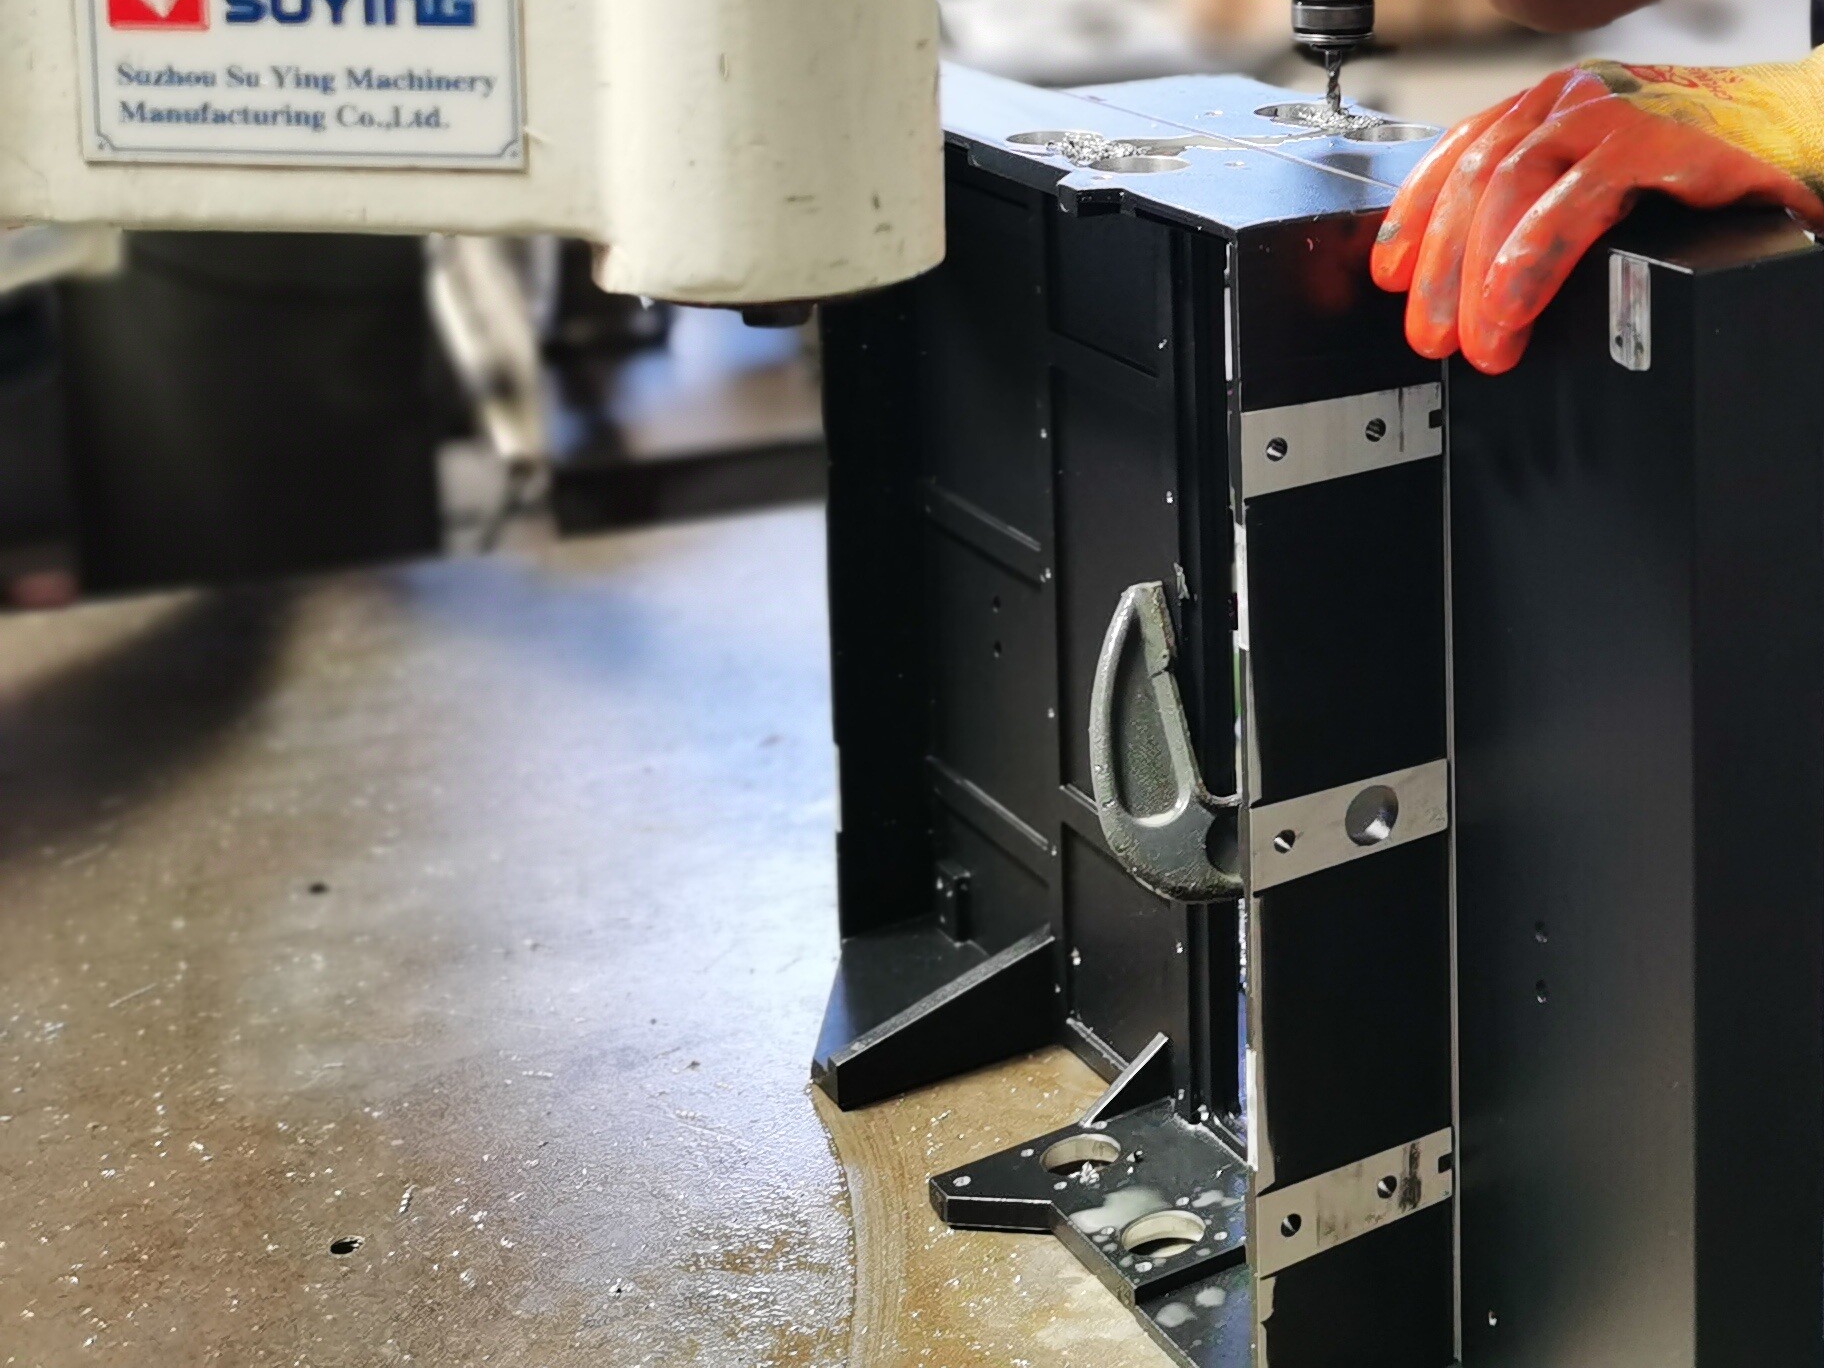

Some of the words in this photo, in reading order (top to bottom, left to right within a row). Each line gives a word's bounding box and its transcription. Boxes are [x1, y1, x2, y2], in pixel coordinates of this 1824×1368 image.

[116, 63, 217, 88] Suzhou
[226, 65, 261, 88] Su
[270, 65, 336, 95] Ying
[346, 67, 497, 98] Machinery
[118, 100, 328, 131] Manufacturing
